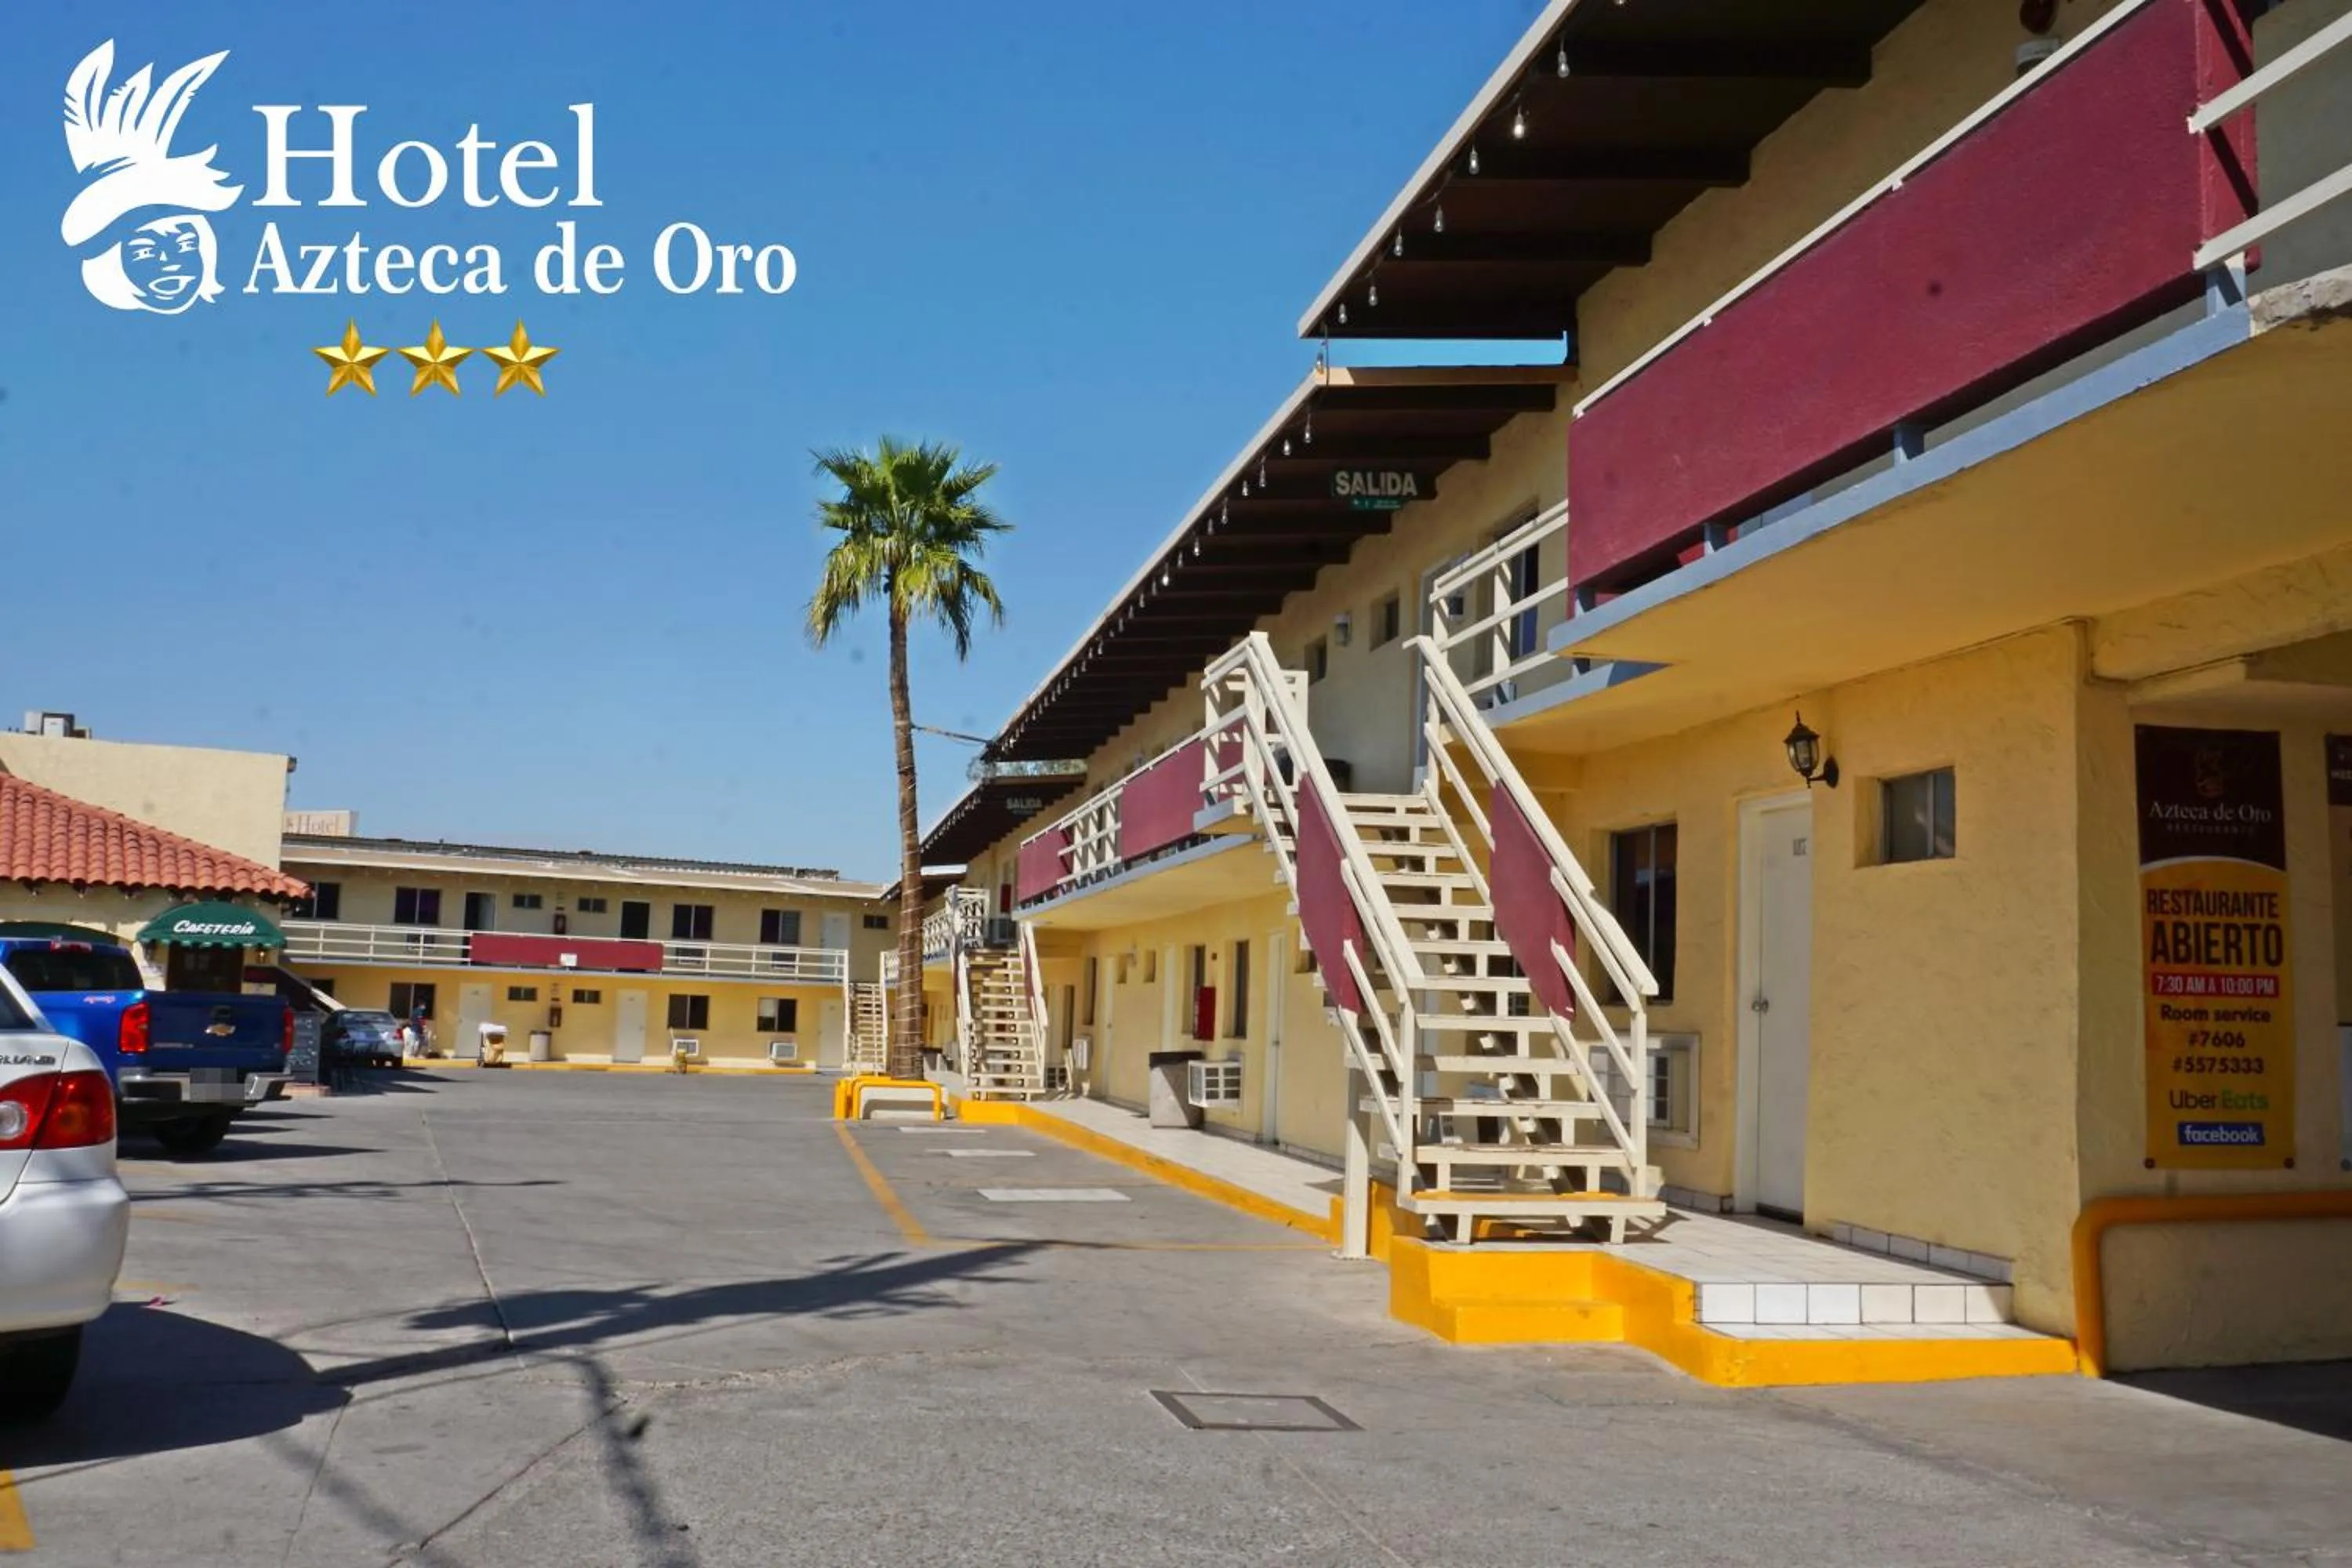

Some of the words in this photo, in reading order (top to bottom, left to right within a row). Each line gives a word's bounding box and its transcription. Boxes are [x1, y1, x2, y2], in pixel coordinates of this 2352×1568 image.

[1335, 470, 1417, 495] SALIDA
[2148, 800, 2208, 820] Azteca
[2213, 803, 2234, 821] de
[2238, 804, 2271, 823] Oro
[2147, 889, 2279, 918] RESTAURANTE
[2151, 920, 2283, 967] ABIERTO
[2187, 977, 2205, 993] AM
[2221, 978, 2252, 994] 10:00
[2256, 978, 2275, 995] PM
[2160, 1004, 2209, 1022] Room
[2214, 1007, 2271, 1022] service
[2189, 1031, 2245, 1048] #7606
[2169, 1090, 2217, 1109] Uber
[2221, 1090, 2268, 1110] Eats
[2183, 1125, 2259, 1142] facebook
